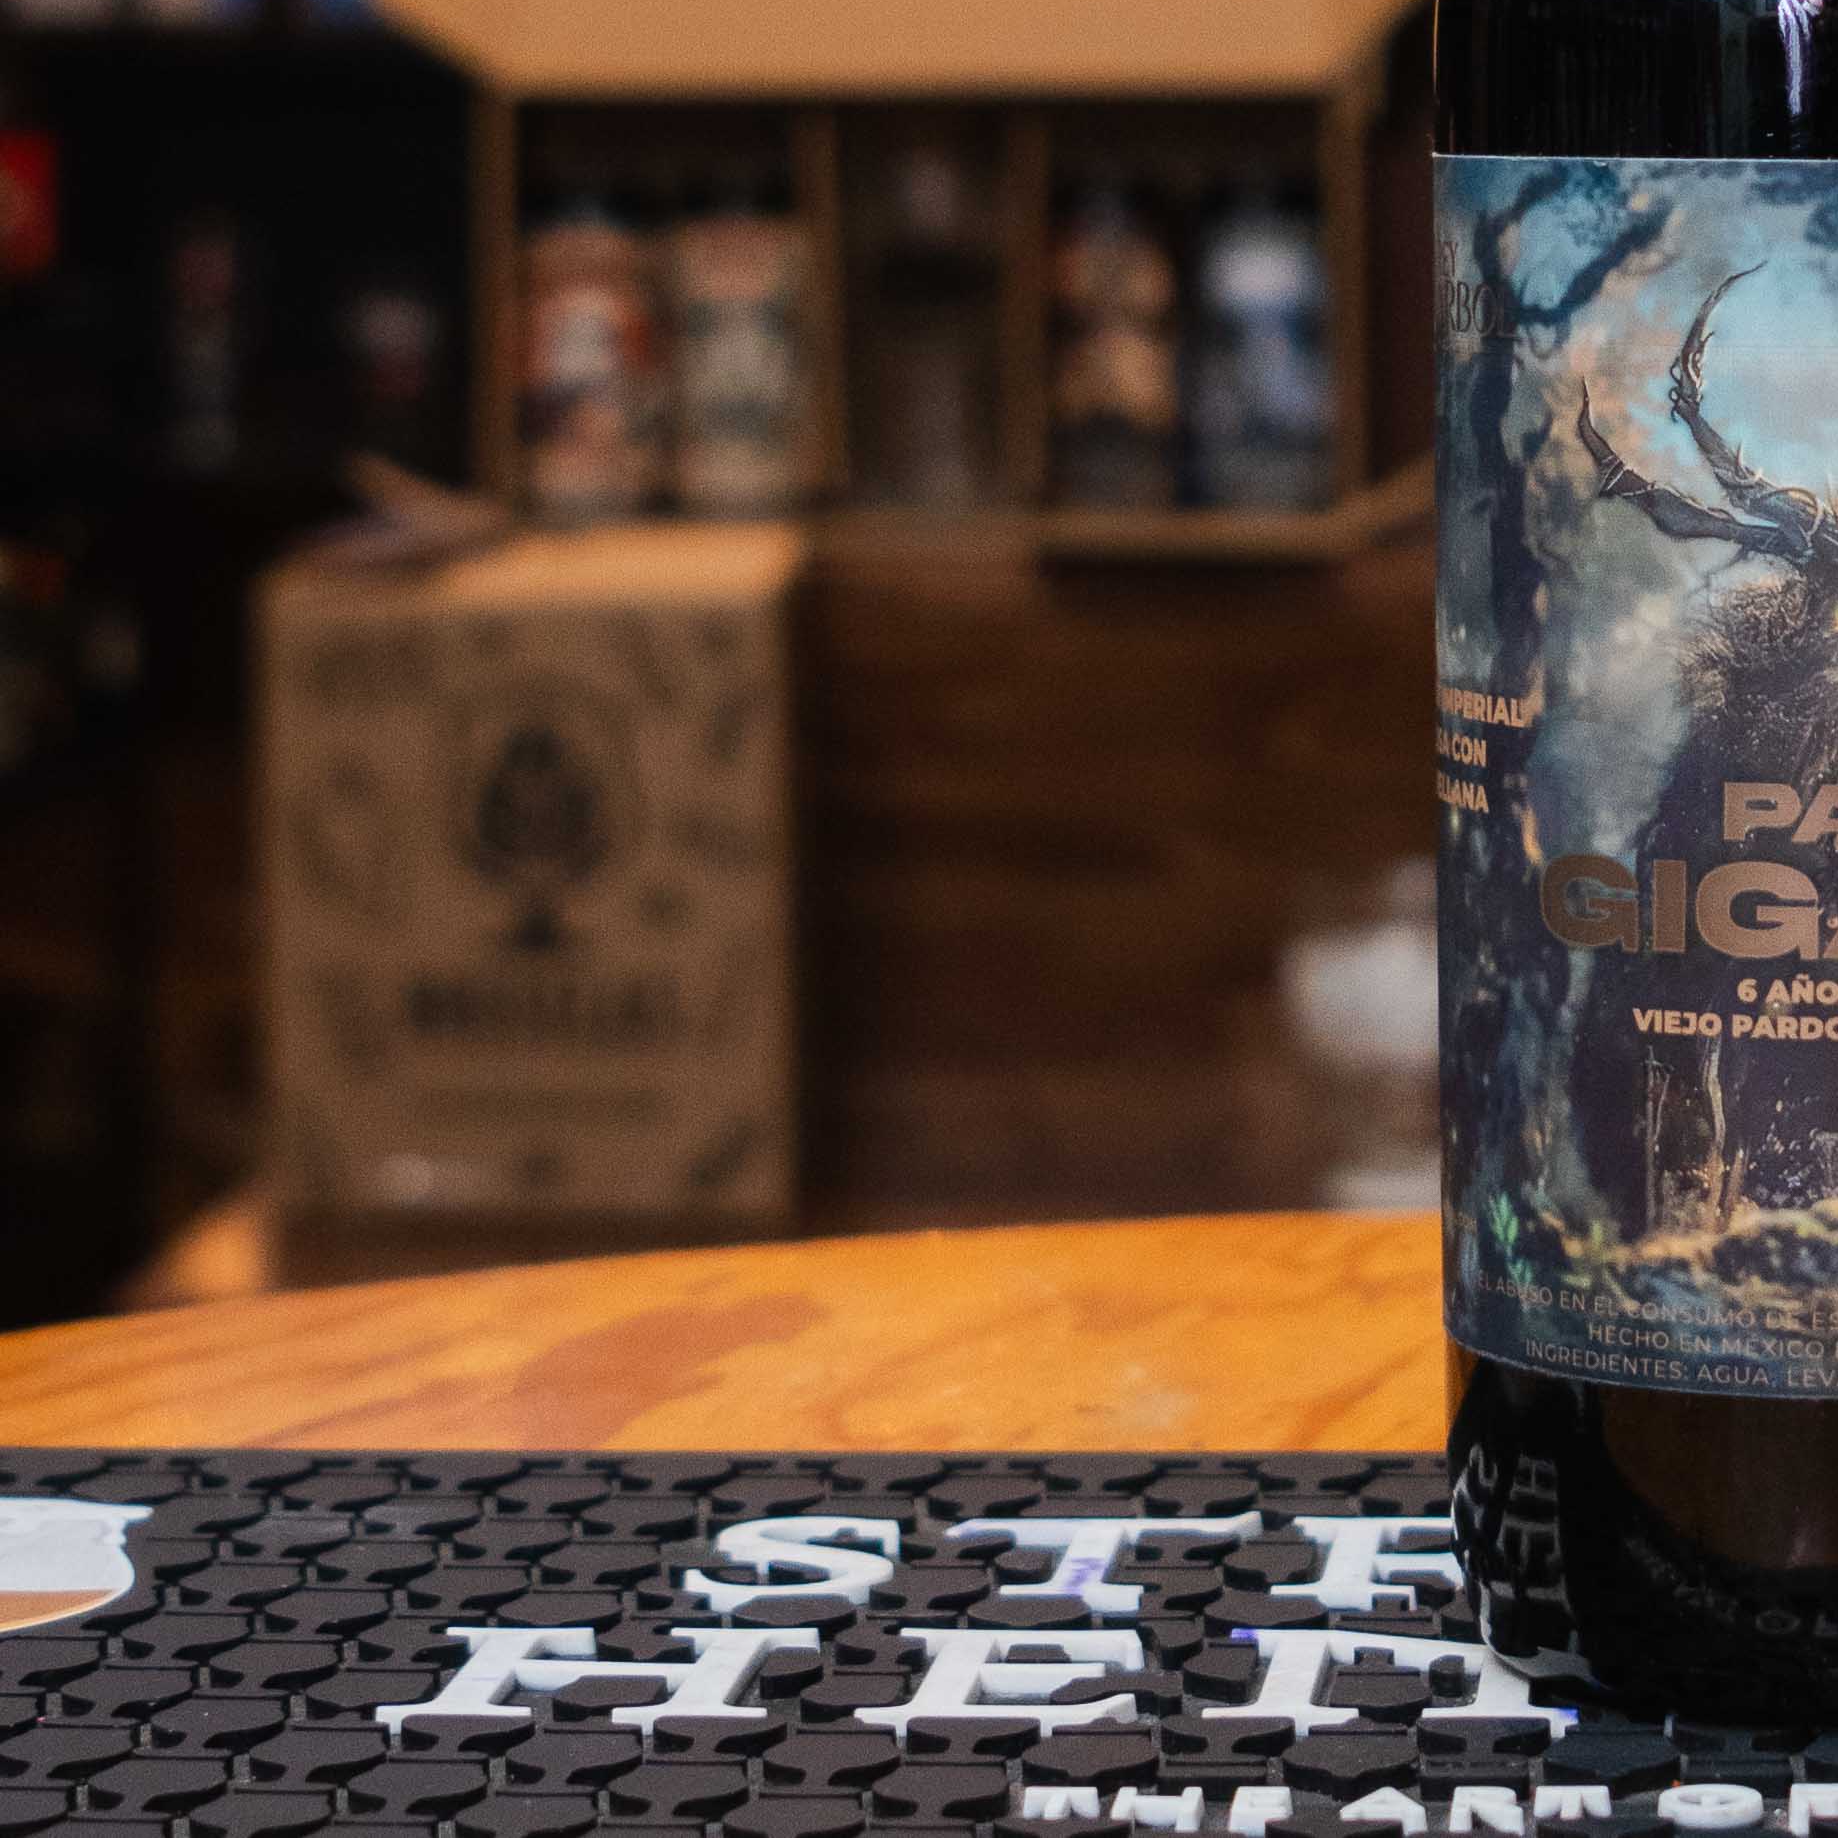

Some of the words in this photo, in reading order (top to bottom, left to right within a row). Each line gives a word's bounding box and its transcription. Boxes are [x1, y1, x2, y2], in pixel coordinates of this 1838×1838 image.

[1737, 978, 1758, 1003] 6
[1632, 1007, 1722, 1037] VIEJO
[1560, 1290, 1586, 1311] EN
[1594, 1295, 1617, 1317] EL
[1588, 1321, 1669, 1349] HECHO
[1680, 1334, 1713, 1354] EN
